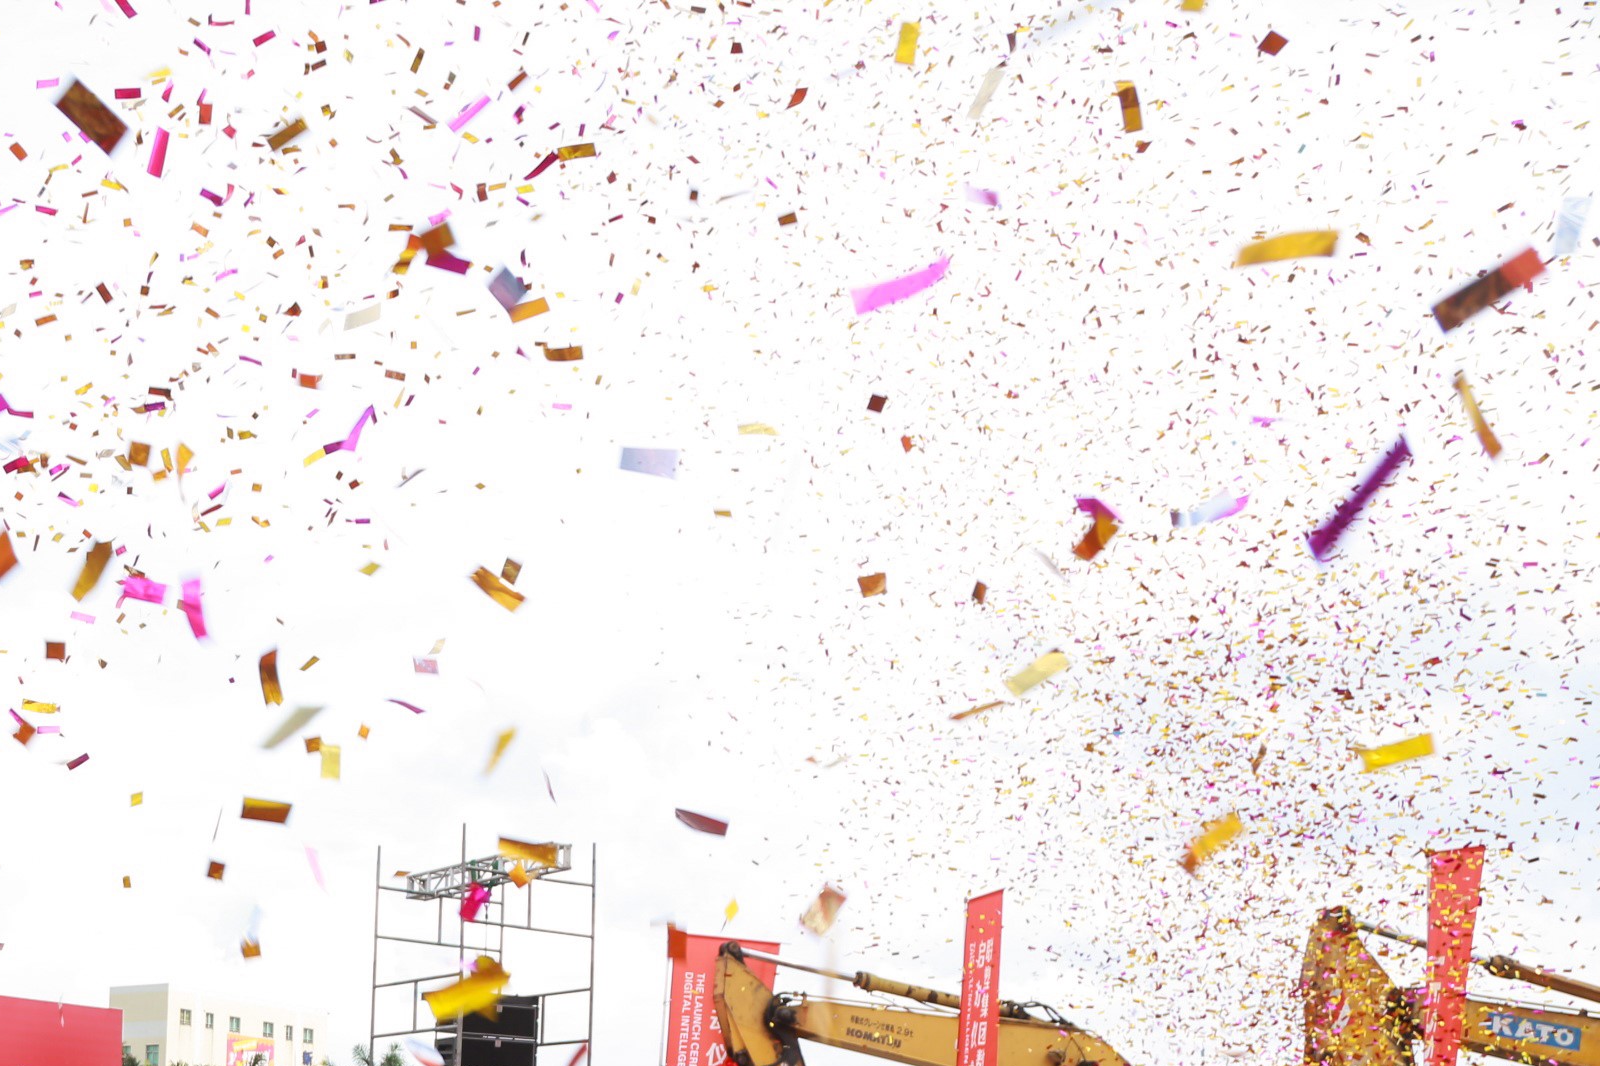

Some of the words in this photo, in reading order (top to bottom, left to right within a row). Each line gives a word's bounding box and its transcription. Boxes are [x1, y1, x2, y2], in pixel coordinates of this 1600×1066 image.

[681, 971, 694, 1014] DIGITAL
[695, 972, 706, 994] THE
[691, 995, 704, 1041] LAUNCH
[1490, 1014, 1576, 1048] KATO
